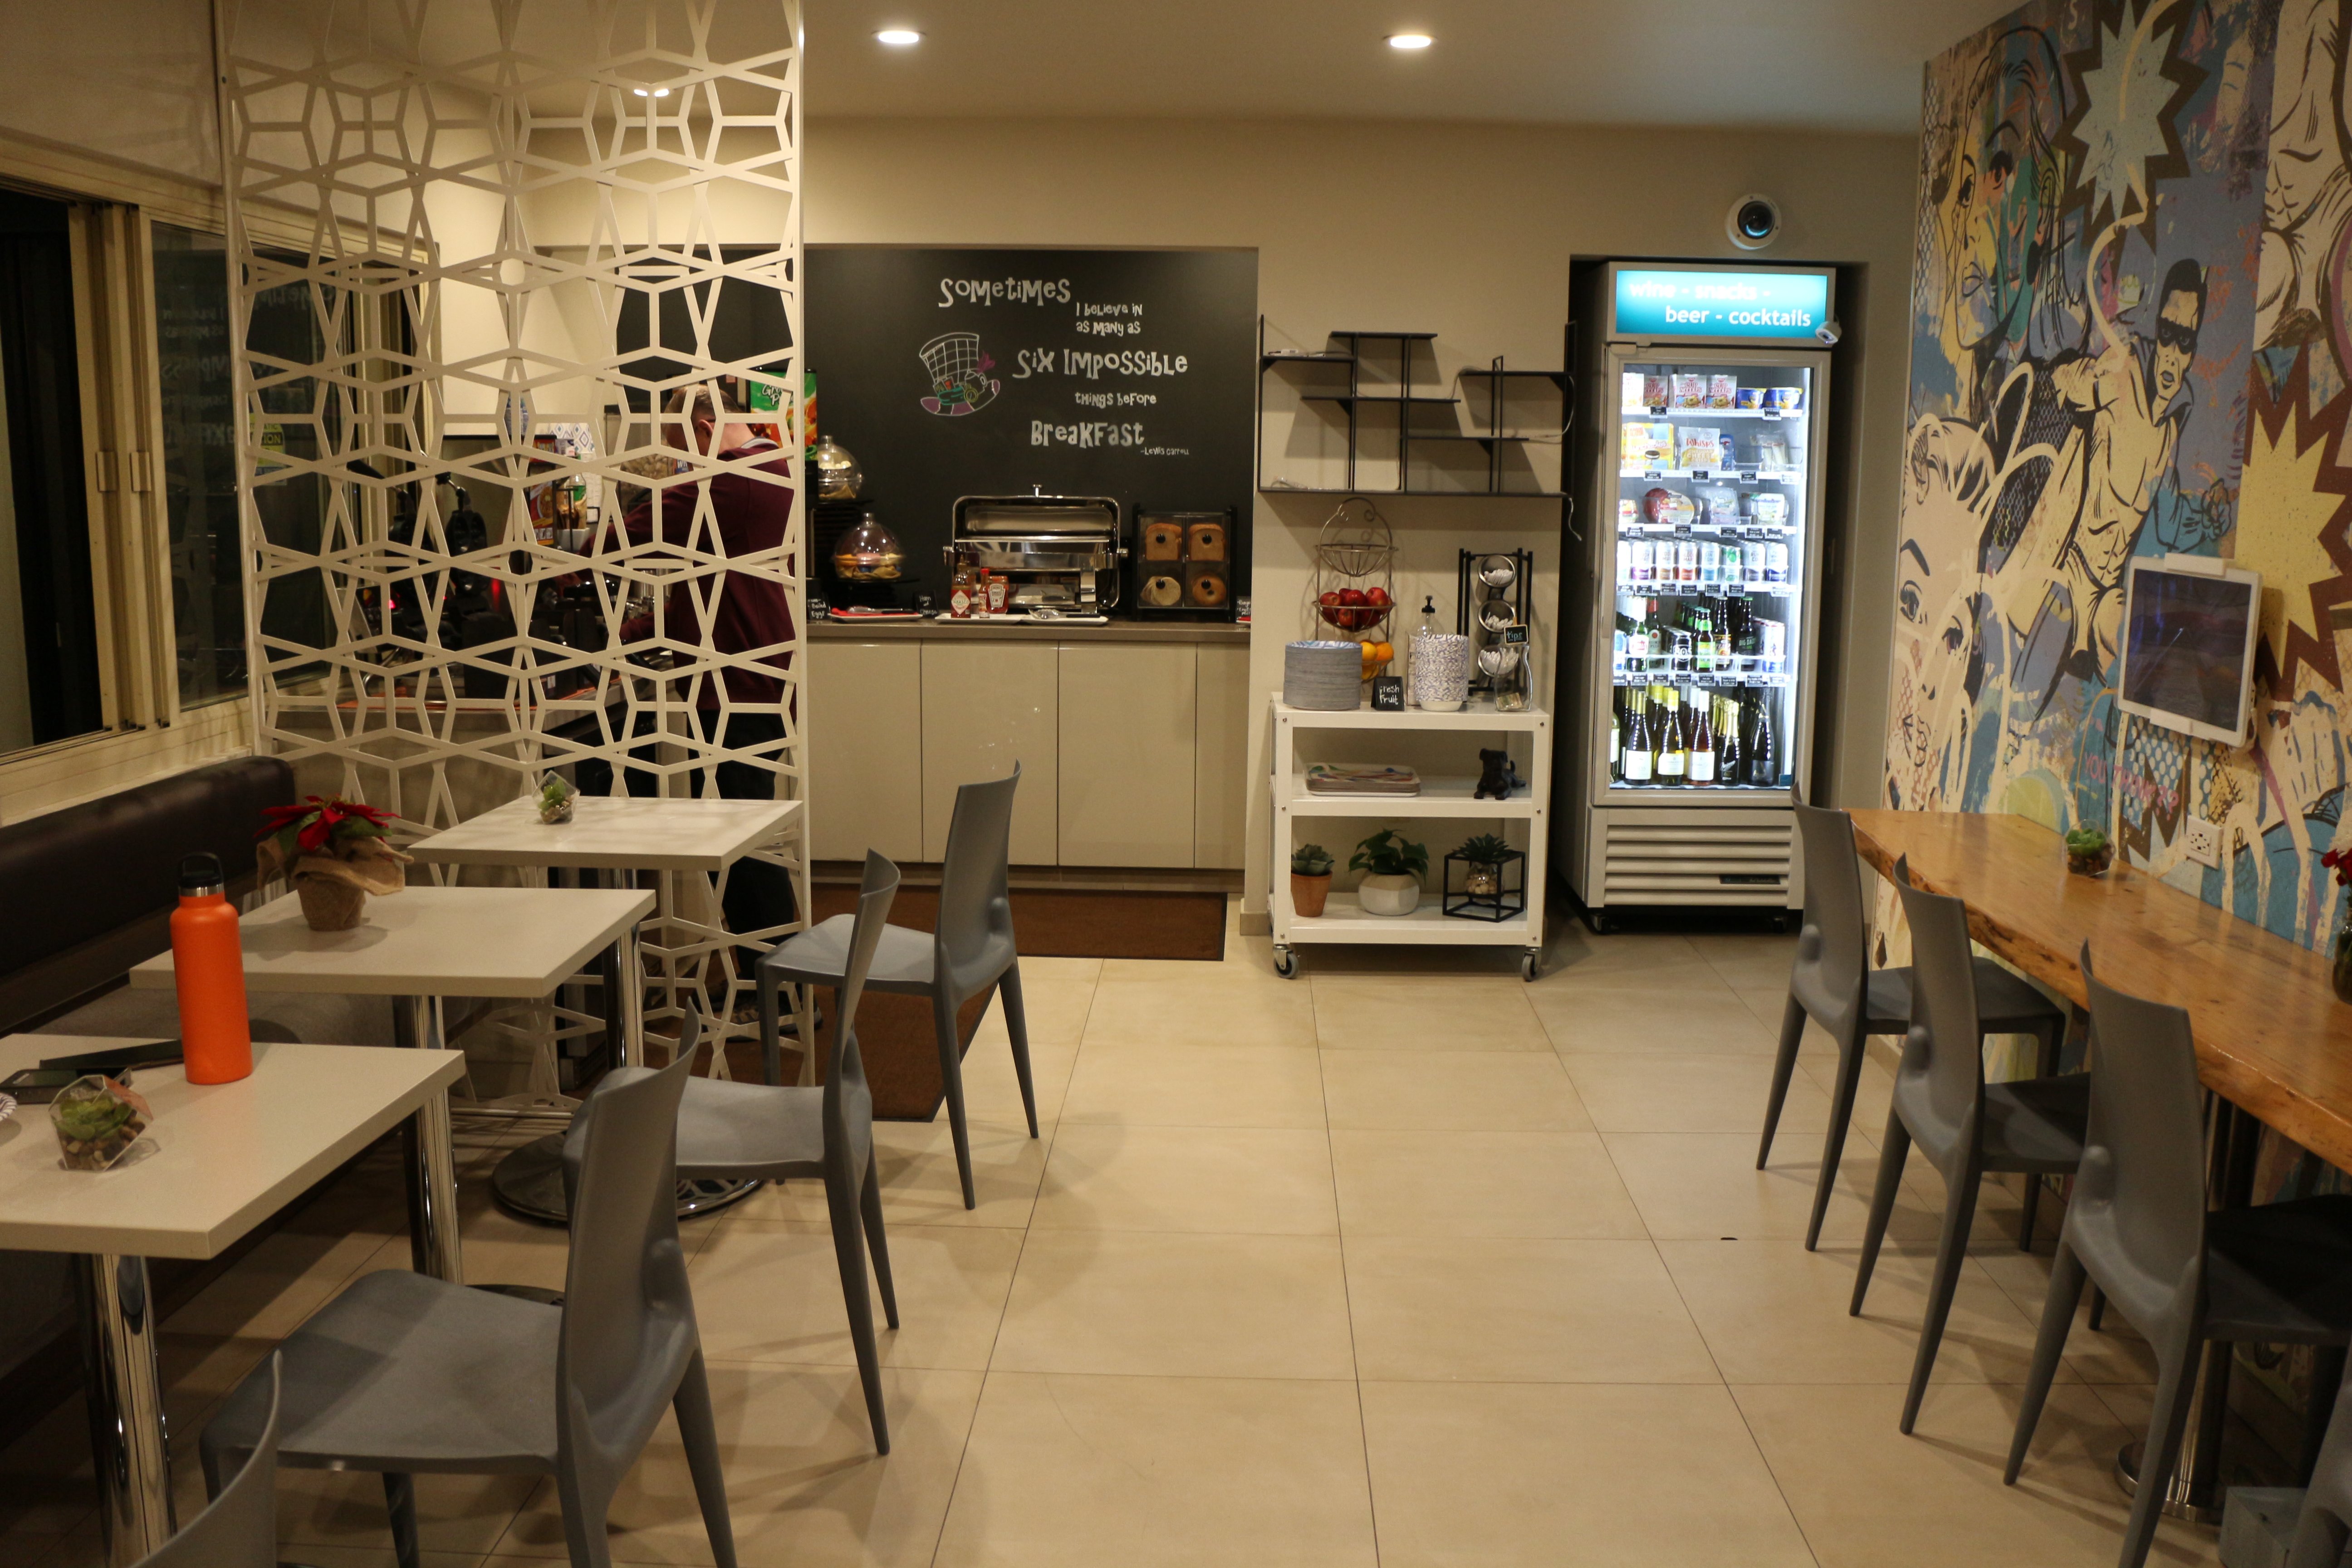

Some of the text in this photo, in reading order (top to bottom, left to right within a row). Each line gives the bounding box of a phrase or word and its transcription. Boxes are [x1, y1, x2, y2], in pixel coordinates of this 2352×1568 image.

[1629, 280, 1676, 298] wine
[1695, 283, 1757, 299] snacks
[1076, 303, 1080, 316] I
[1665, 305, 1710, 323] beer
[1729, 308, 1811, 327] cocktails
[811, 611, 825, 619] Eggs
[1506, 631, 1523, 642] tips
[1380, 694, 1399, 705] Fruit
[2085, 752, 2107, 784] YOU
